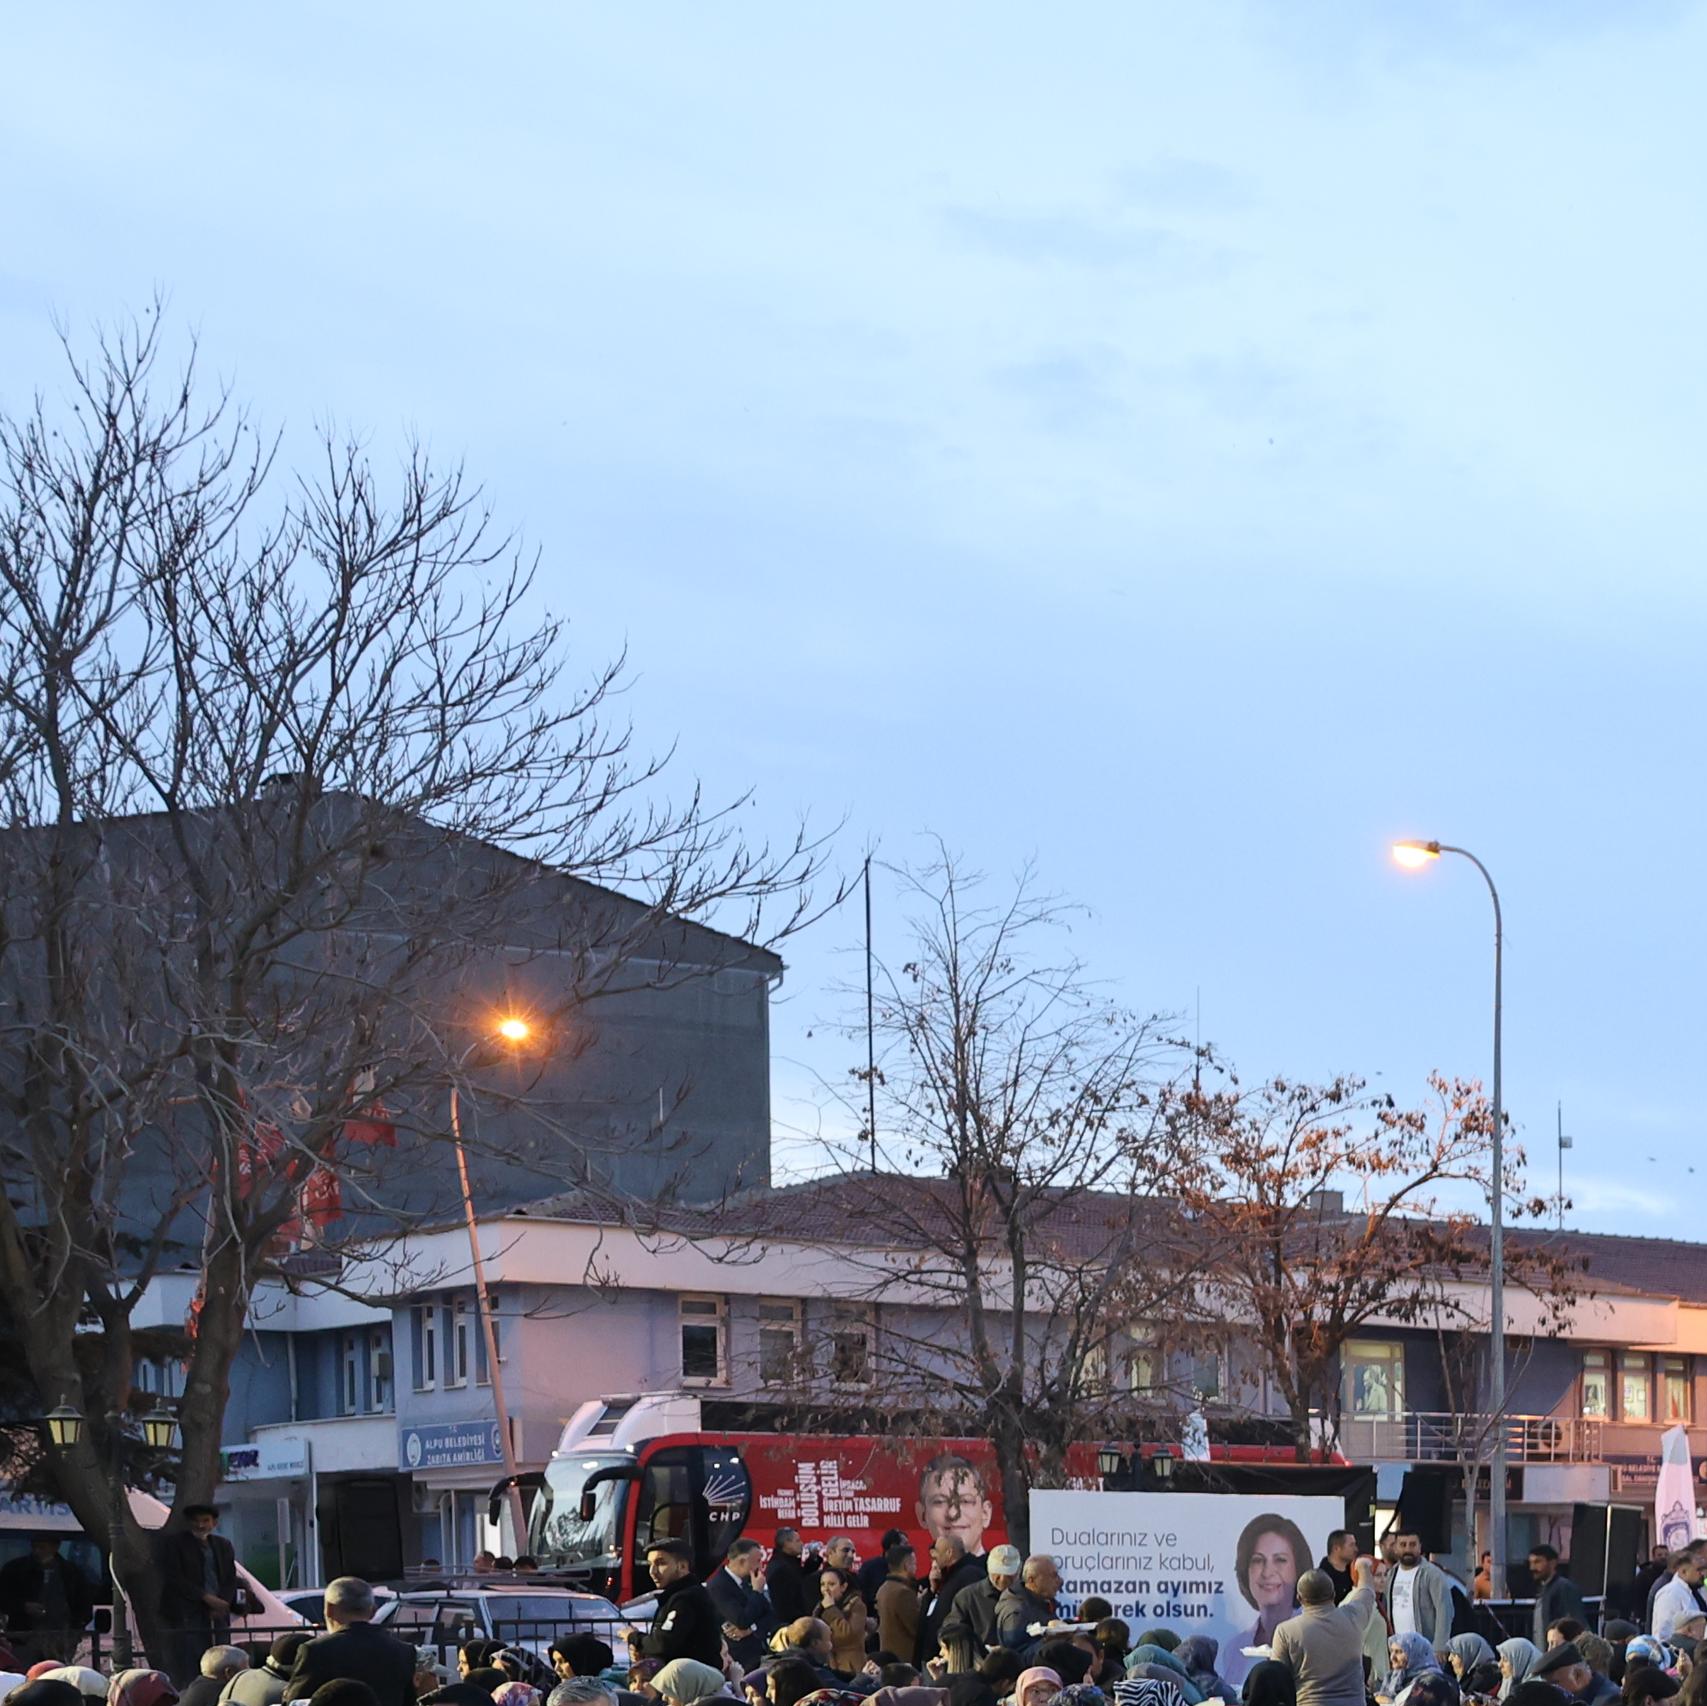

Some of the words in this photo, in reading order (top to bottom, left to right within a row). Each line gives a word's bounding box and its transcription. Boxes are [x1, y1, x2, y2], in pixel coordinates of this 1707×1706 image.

[853, 1497, 902, 1513] TASARRUF
[709, 1511, 741, 1523] CHP
[846, 1512, 870, 1528] GELİR
[1051, 1527, 1147, 1547] Dualarınız
[1154, 1532, 1177, 1547] ve
[1159, 1553, 1215, 1573] kabul,
[1157, 1580, 1224, 1598] ayımız
[1153, 1600, 1214, 1618] olsun.
